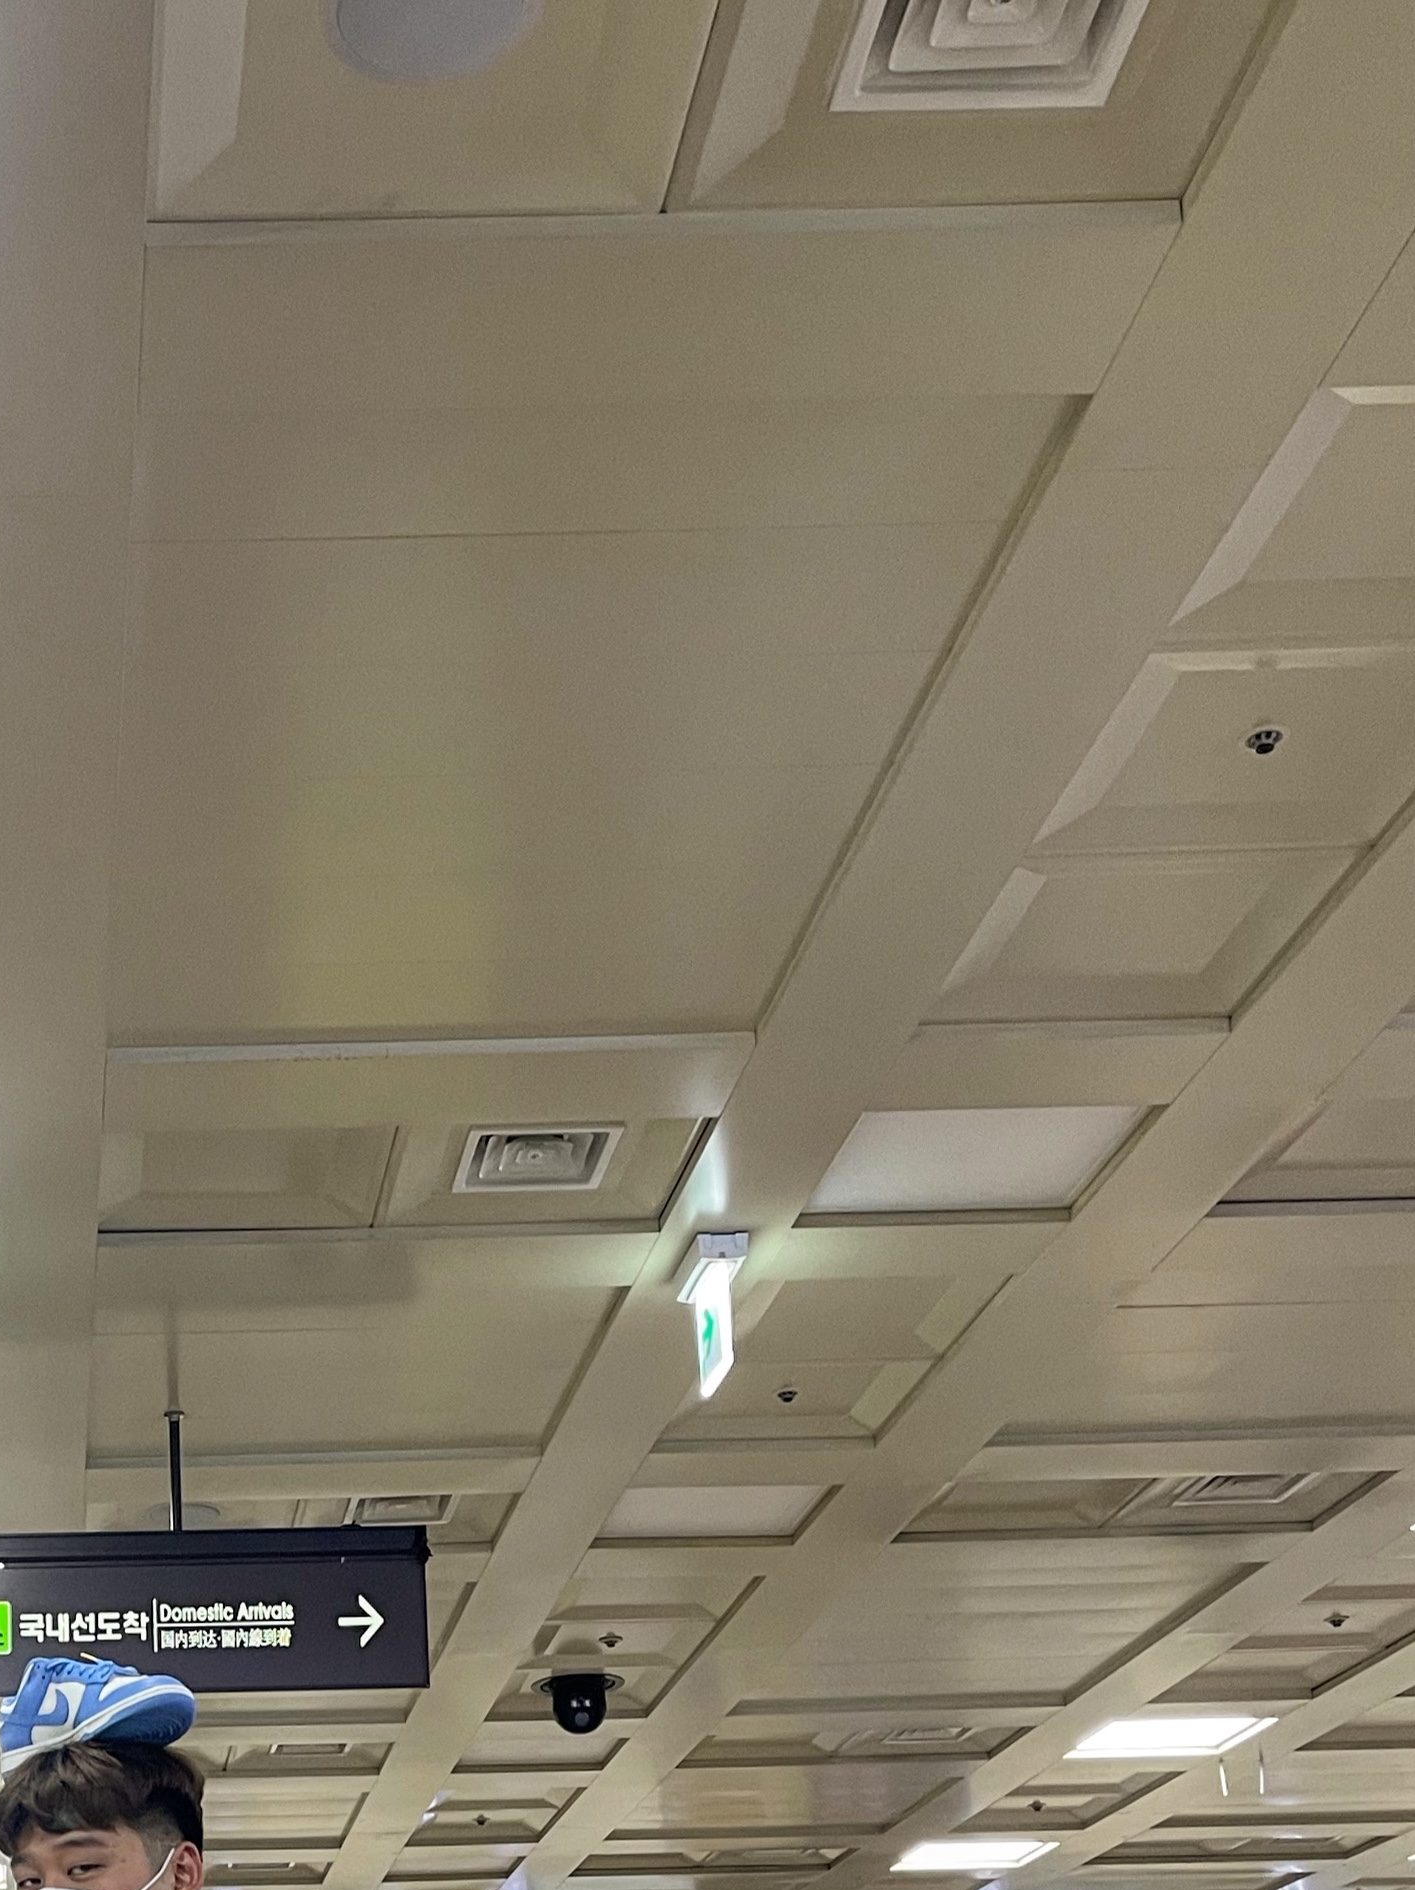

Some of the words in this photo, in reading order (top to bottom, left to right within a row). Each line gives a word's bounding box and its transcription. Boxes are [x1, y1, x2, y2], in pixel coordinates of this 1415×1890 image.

[159, 1602, 234, 1622] Domestic
[237, 1600, 295, 1620] Arrivals
[19, 1610, 150, 1643] 국내선도착
